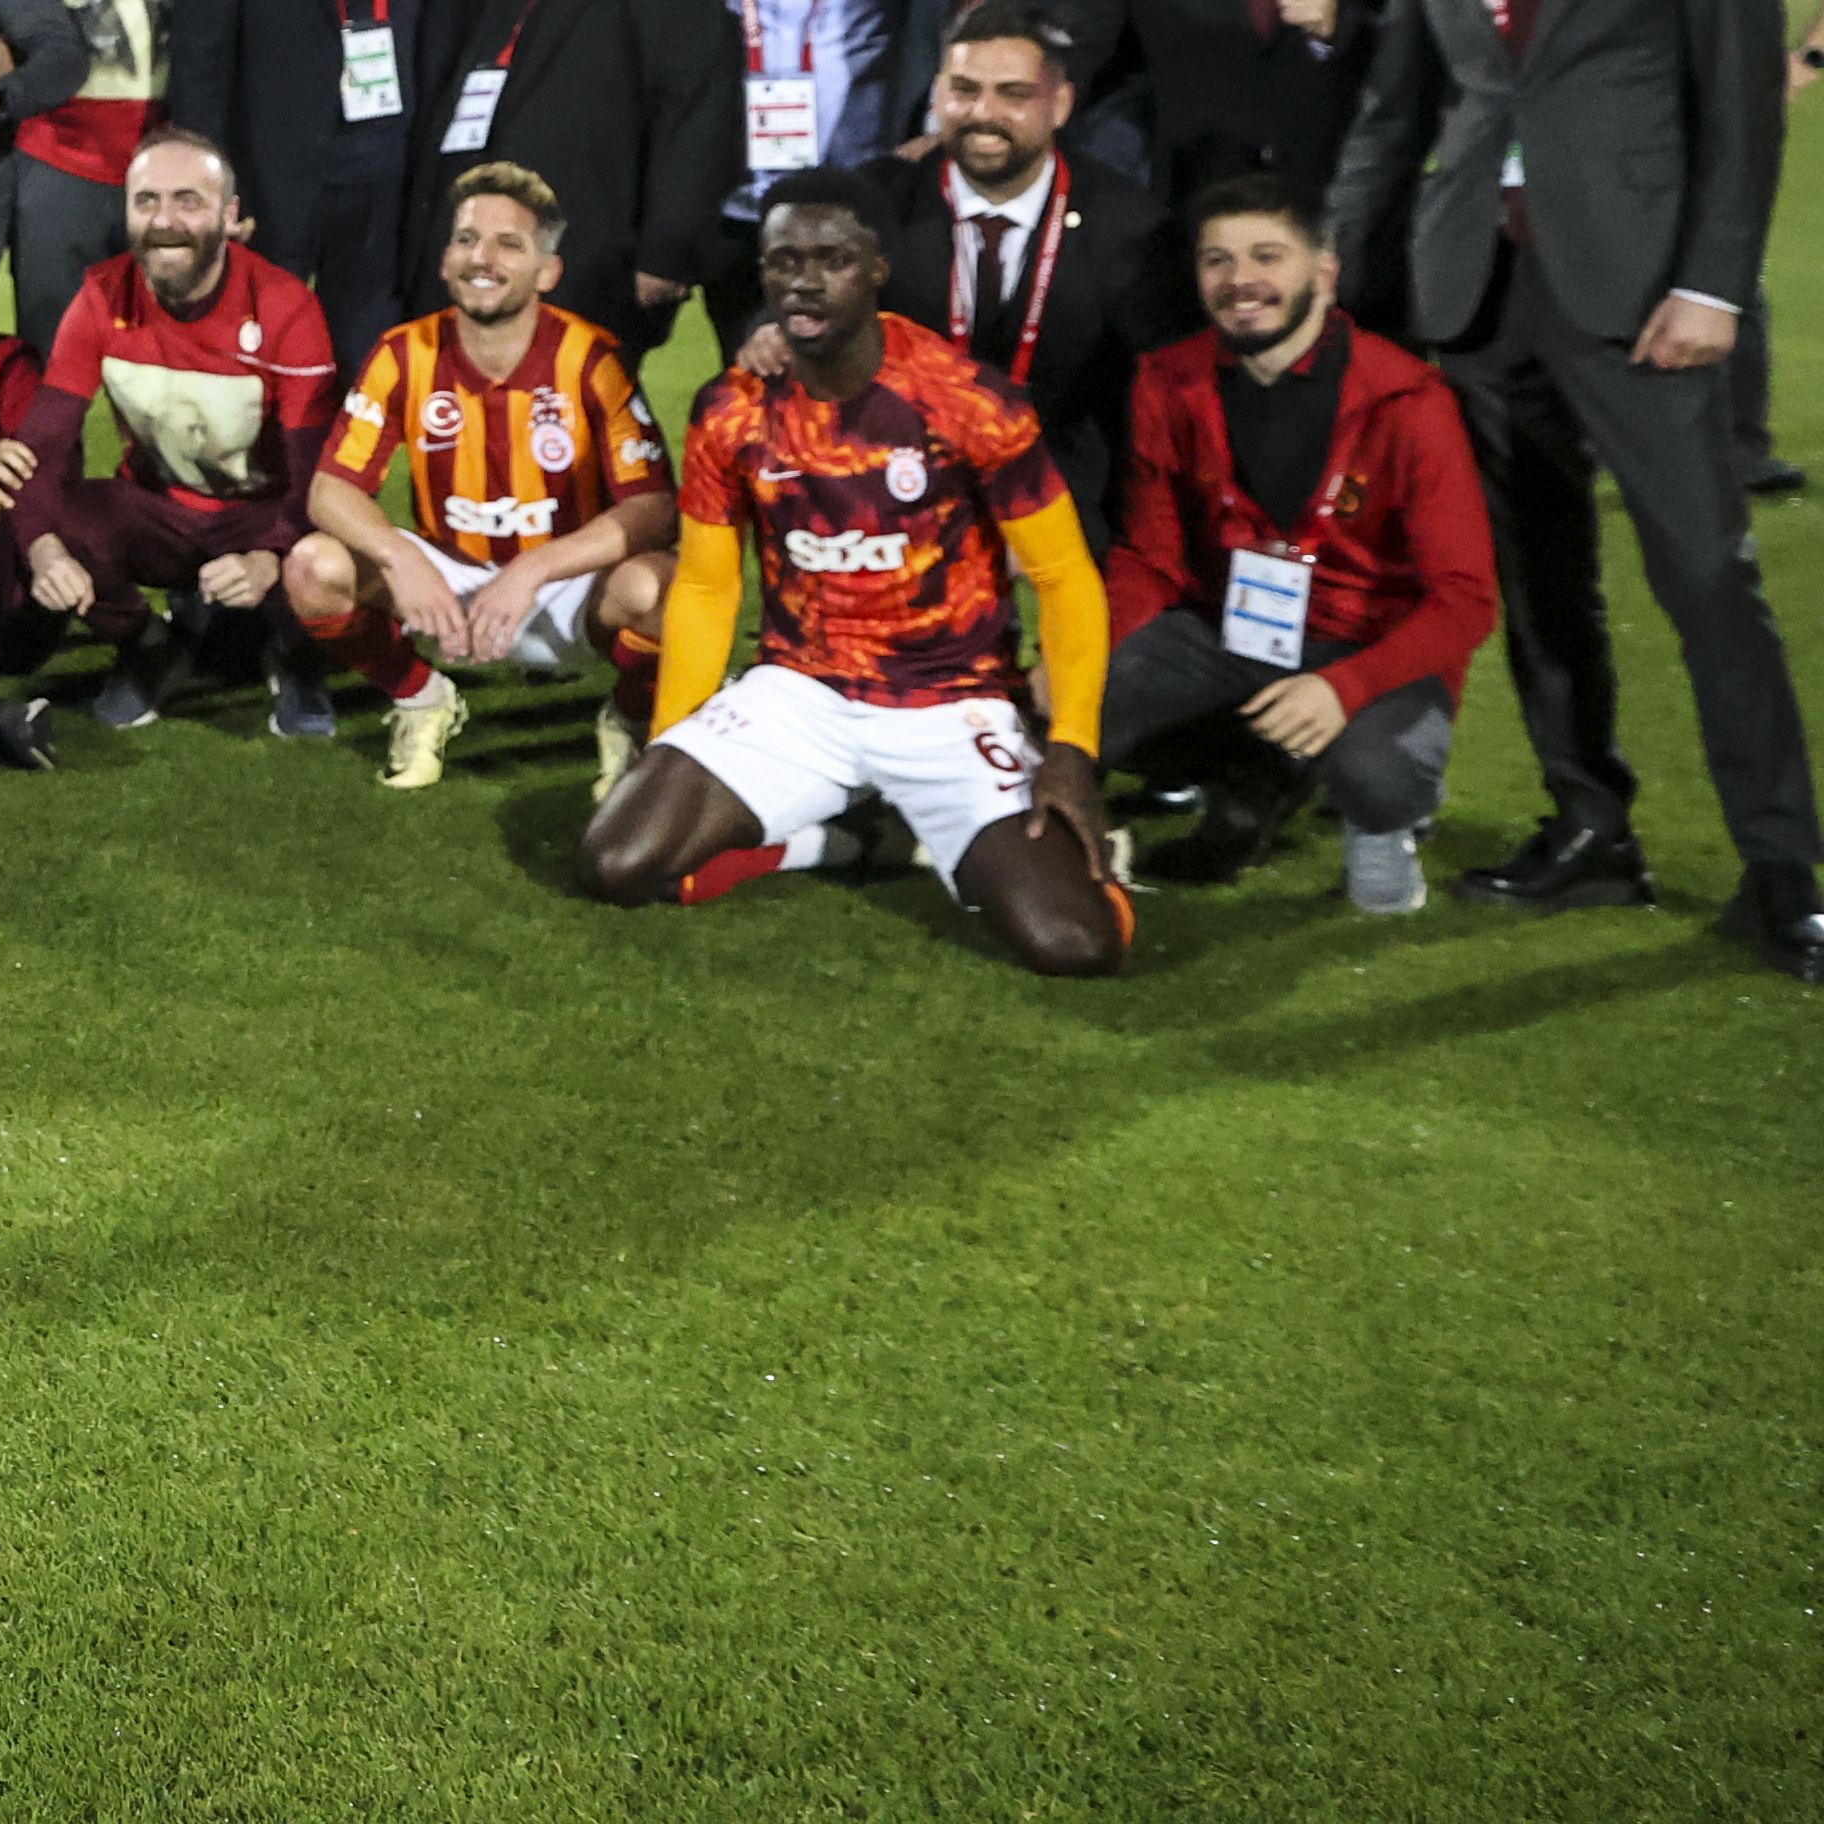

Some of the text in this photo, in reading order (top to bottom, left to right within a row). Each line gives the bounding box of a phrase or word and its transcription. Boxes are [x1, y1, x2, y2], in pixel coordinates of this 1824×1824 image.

[444, 495, 559, 537] SIXT
[785, 529, 910, 572] SIXT
[975, 731, 1023, 773] 6
